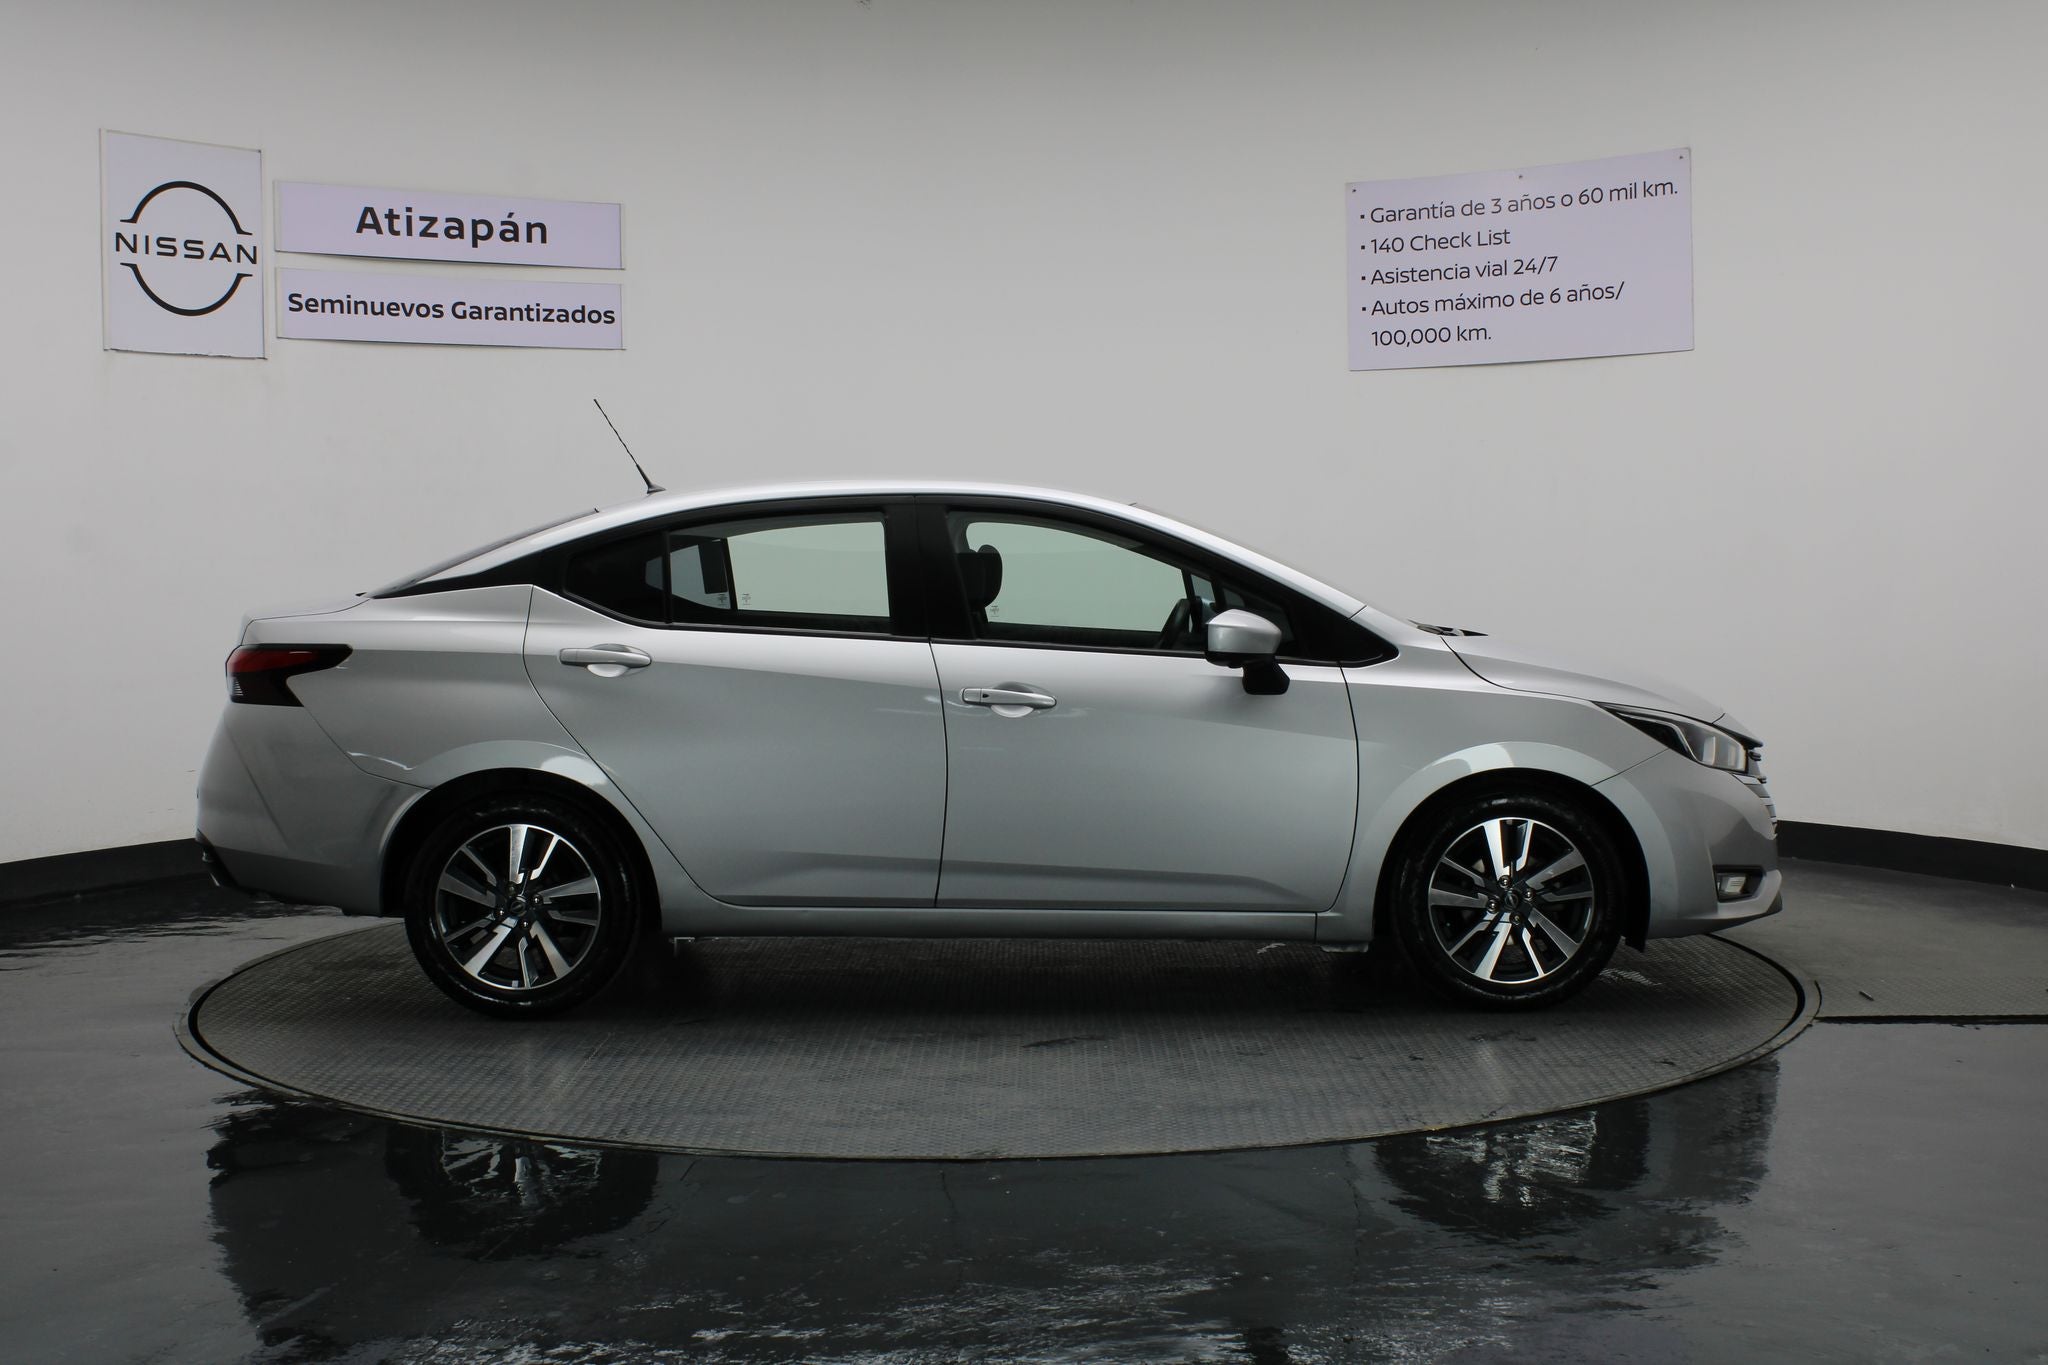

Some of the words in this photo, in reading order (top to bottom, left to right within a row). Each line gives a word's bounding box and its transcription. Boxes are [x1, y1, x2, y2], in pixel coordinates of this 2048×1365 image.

[1370, 200, 1455, 224] Garantía
[1460, 199, 1486, 217] de
[1490, 197, 1502, 215] 3
[1507, 193, 1556, 213] años
[1560, 193, 1574, 208] o
[1578, 186, 1604, 206] 60
[1609, 181, 1638, 202] mil
[1642, 180, 1678, 198] km.
[355, 206, 548, 249] Atizapán
[1370, 236, 1405, 255] 140
[1409, 231, 1472, 252] Check
[1477, 228, 1511, 247] List
[115, 231, 258, 265] NISSAN
[1370, 263, 1471, 286] Asistencia
[1474, 259, 1508, 278] vial
[1513, 255, 1559, 276] 24/7
[287, 292, 445, 319] Seminuevos
[451, 301, 616, 325] Garantizados
[1370, 298, 1430, 316] Autos
[1434, 292, 1515, 313] máximo
[1519, 288, 1545, 306] de
[1549, 287, 1562, 304] 6
[1566, 280, 1625, 303] años/
[1371, 326, 1452, 348] 100,000
[1456, 325, 1492, 342] km.
